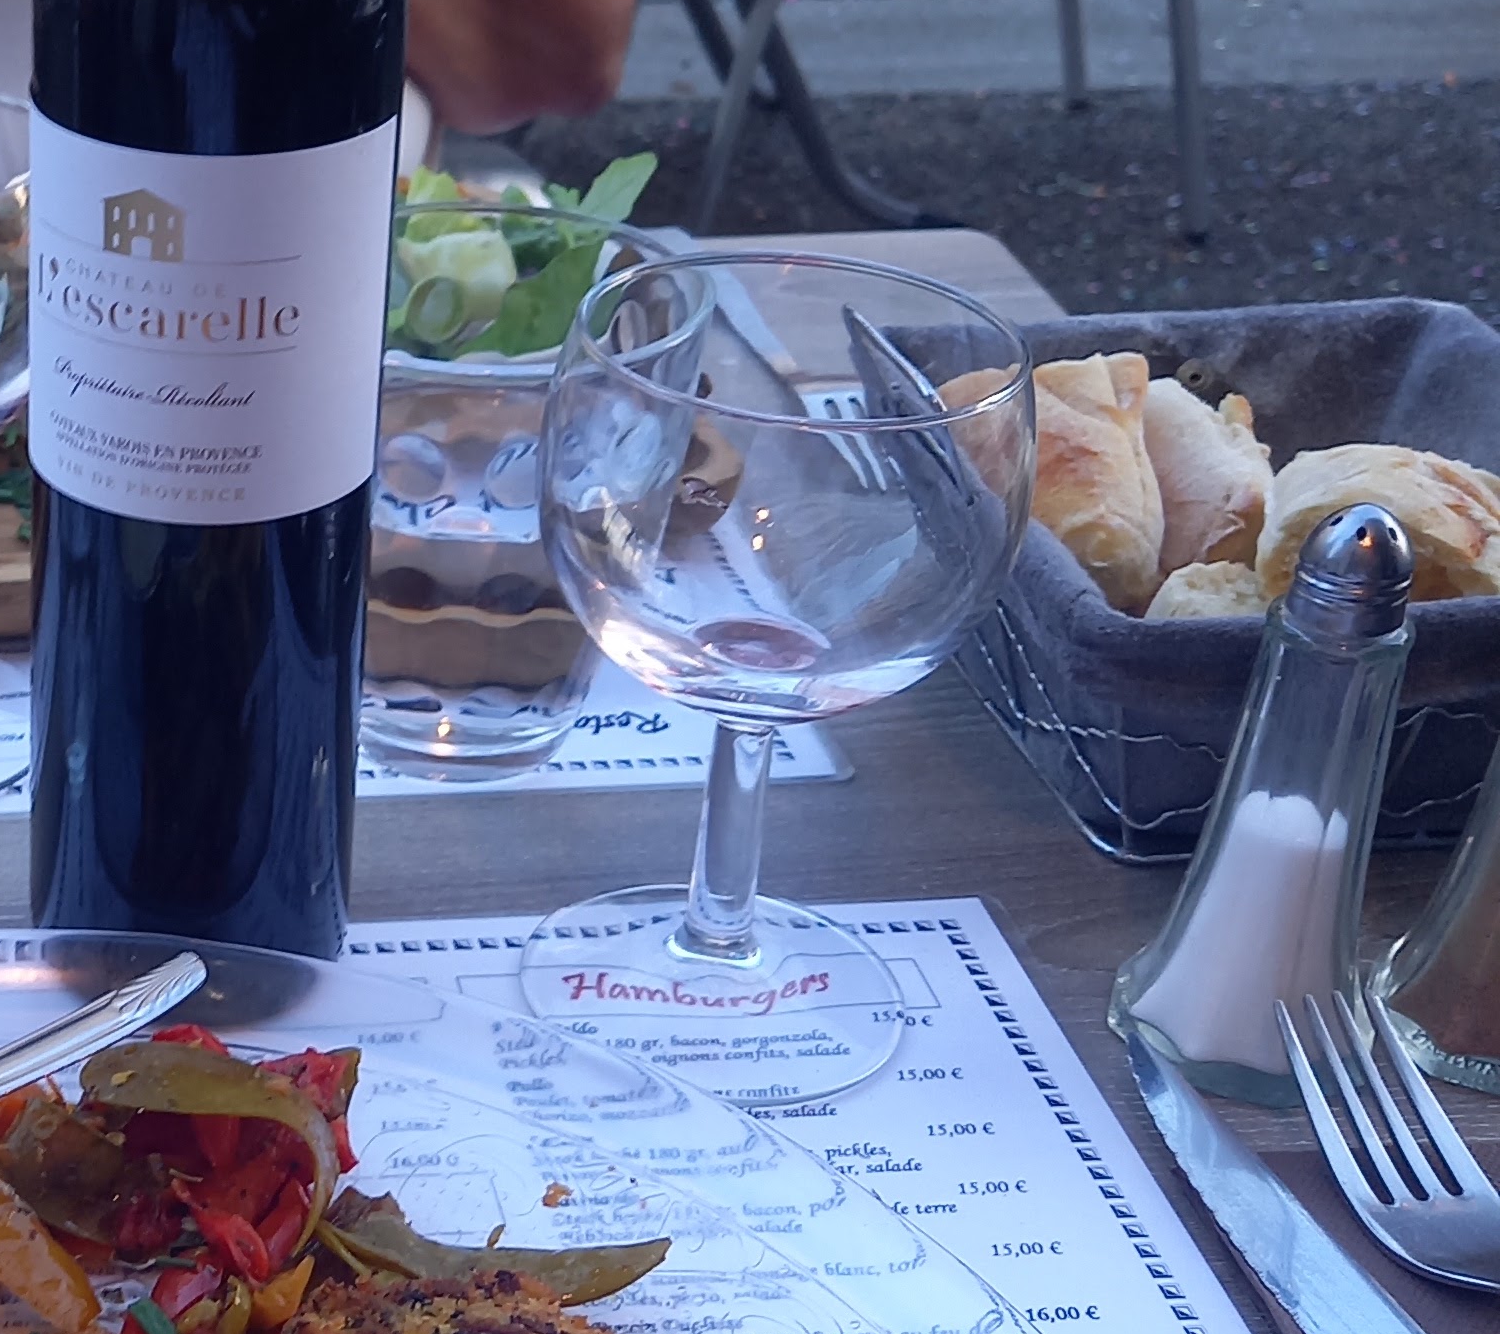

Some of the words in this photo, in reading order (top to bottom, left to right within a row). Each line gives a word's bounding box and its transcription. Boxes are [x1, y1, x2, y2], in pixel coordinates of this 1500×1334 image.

[561, 970, 830, 1017] Hamburgers
[670, 1033, 728, 1050] bacon,
[731, 1029, 834, 1049] gorgonzola,
[651, 1048, 720, 1065] oignons
[723, 1044, 791, 1063] confits,
[795, 1043, 851, 1058] salade
[896, 1067, 947, 1083] 15,00
[950, 1066, 964, 1081] €
[781, 1103, 838, 1119] salade
[927, 1122, 978, 1138] 15,00
[982, 1121, 996, 1136] €
[824, 1142, 893, 1162] pickles,
[865, 1157, 924, 1174] salade
[957, 1180, 1010, 1197] 15,00
[1014, 1179, 1029, 1194] €
[914, 1202, 959, 1215] terre
[991, 1241, 1044, 1258] 15,00
[1048, 1240, 1064, 1256] €
[1025, 1305, 1082, 1324] 16,00
[1086, 1305, 1101, 1321] €
